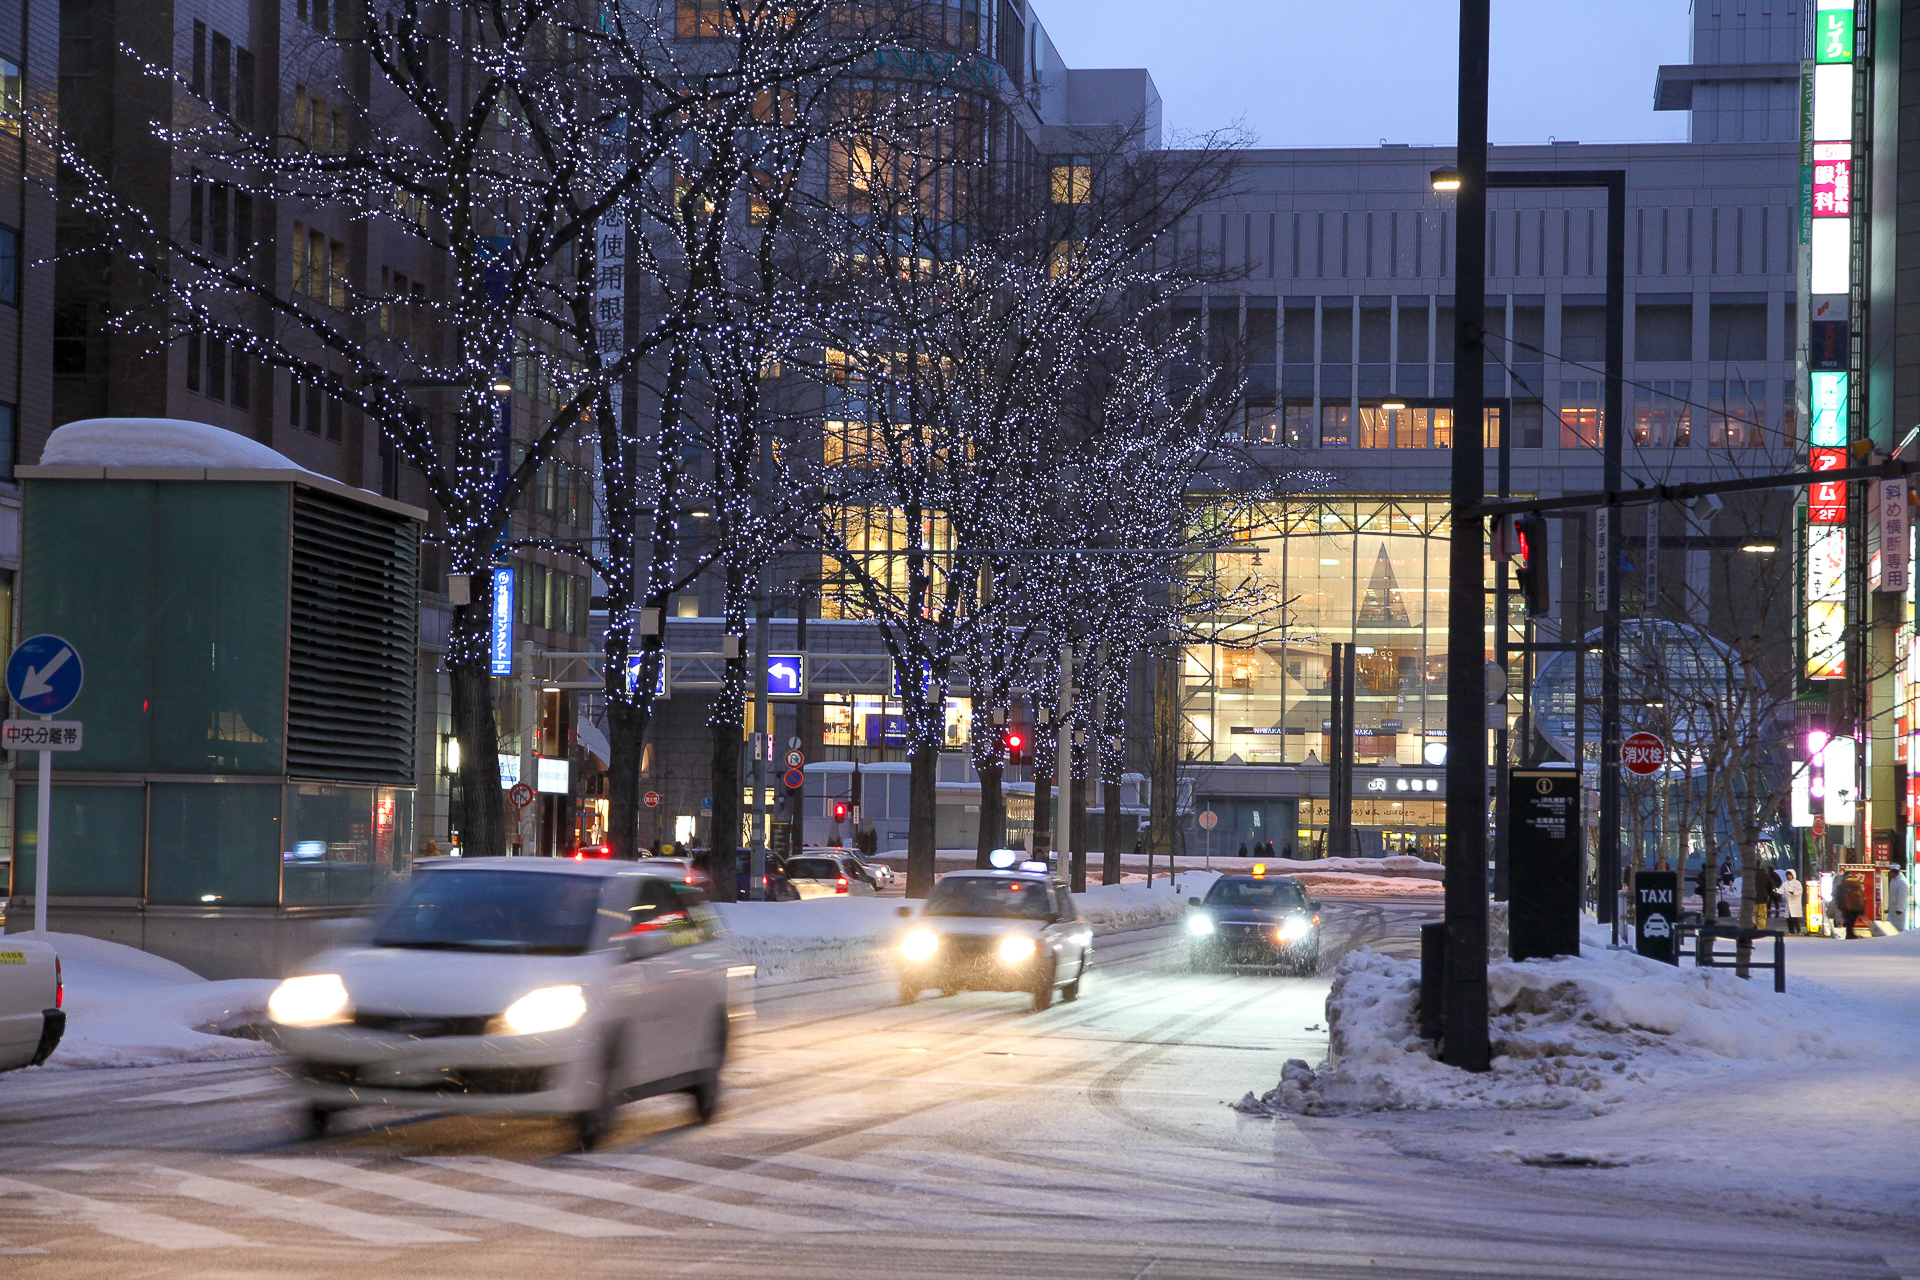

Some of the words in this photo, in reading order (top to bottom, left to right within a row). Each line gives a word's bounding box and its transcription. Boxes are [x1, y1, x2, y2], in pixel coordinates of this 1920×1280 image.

[1826, 14, 1844, 58] レイク
[1814, 166, 1834, 211] 眼科
[1819, 455, 1836, 501] アム
[1819, 510, 1836, 520] 2F
[1885, 484, 1902, 587] 斜め横断専用
[7, 726, 77, 745] 中央分離帯
[1624, 746, 1662, 763] 消火栓
[1639, 889, 1673, 903] TAXI
